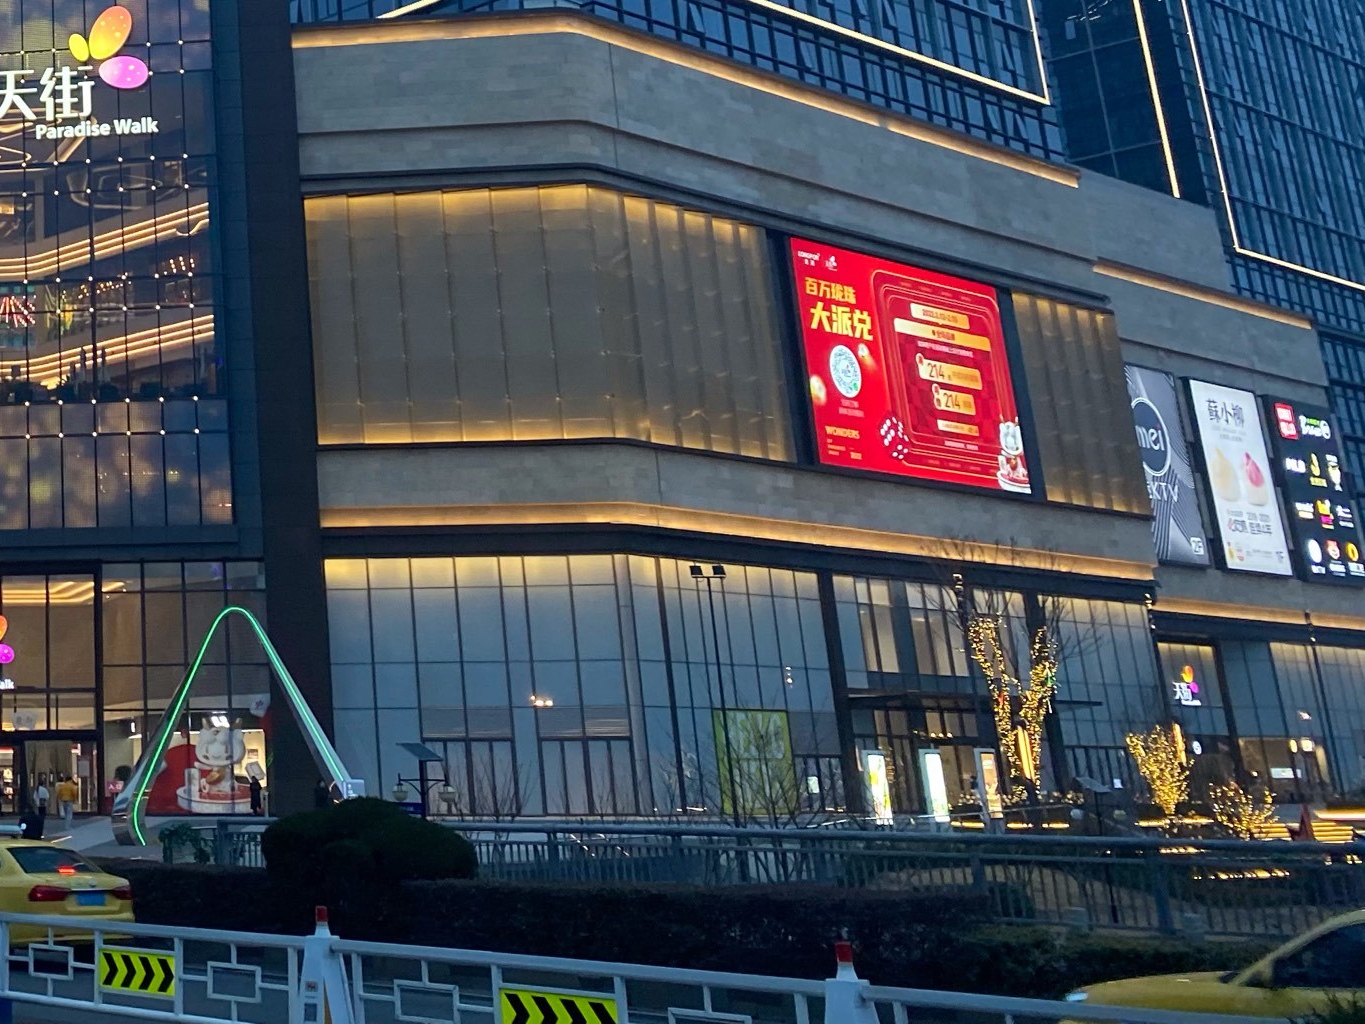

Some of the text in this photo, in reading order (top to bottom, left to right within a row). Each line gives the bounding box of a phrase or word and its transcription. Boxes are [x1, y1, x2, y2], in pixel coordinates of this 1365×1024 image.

[35, 117, 159, 140] Paradise Walk
[810, 301, 874, 341] 大派兑
